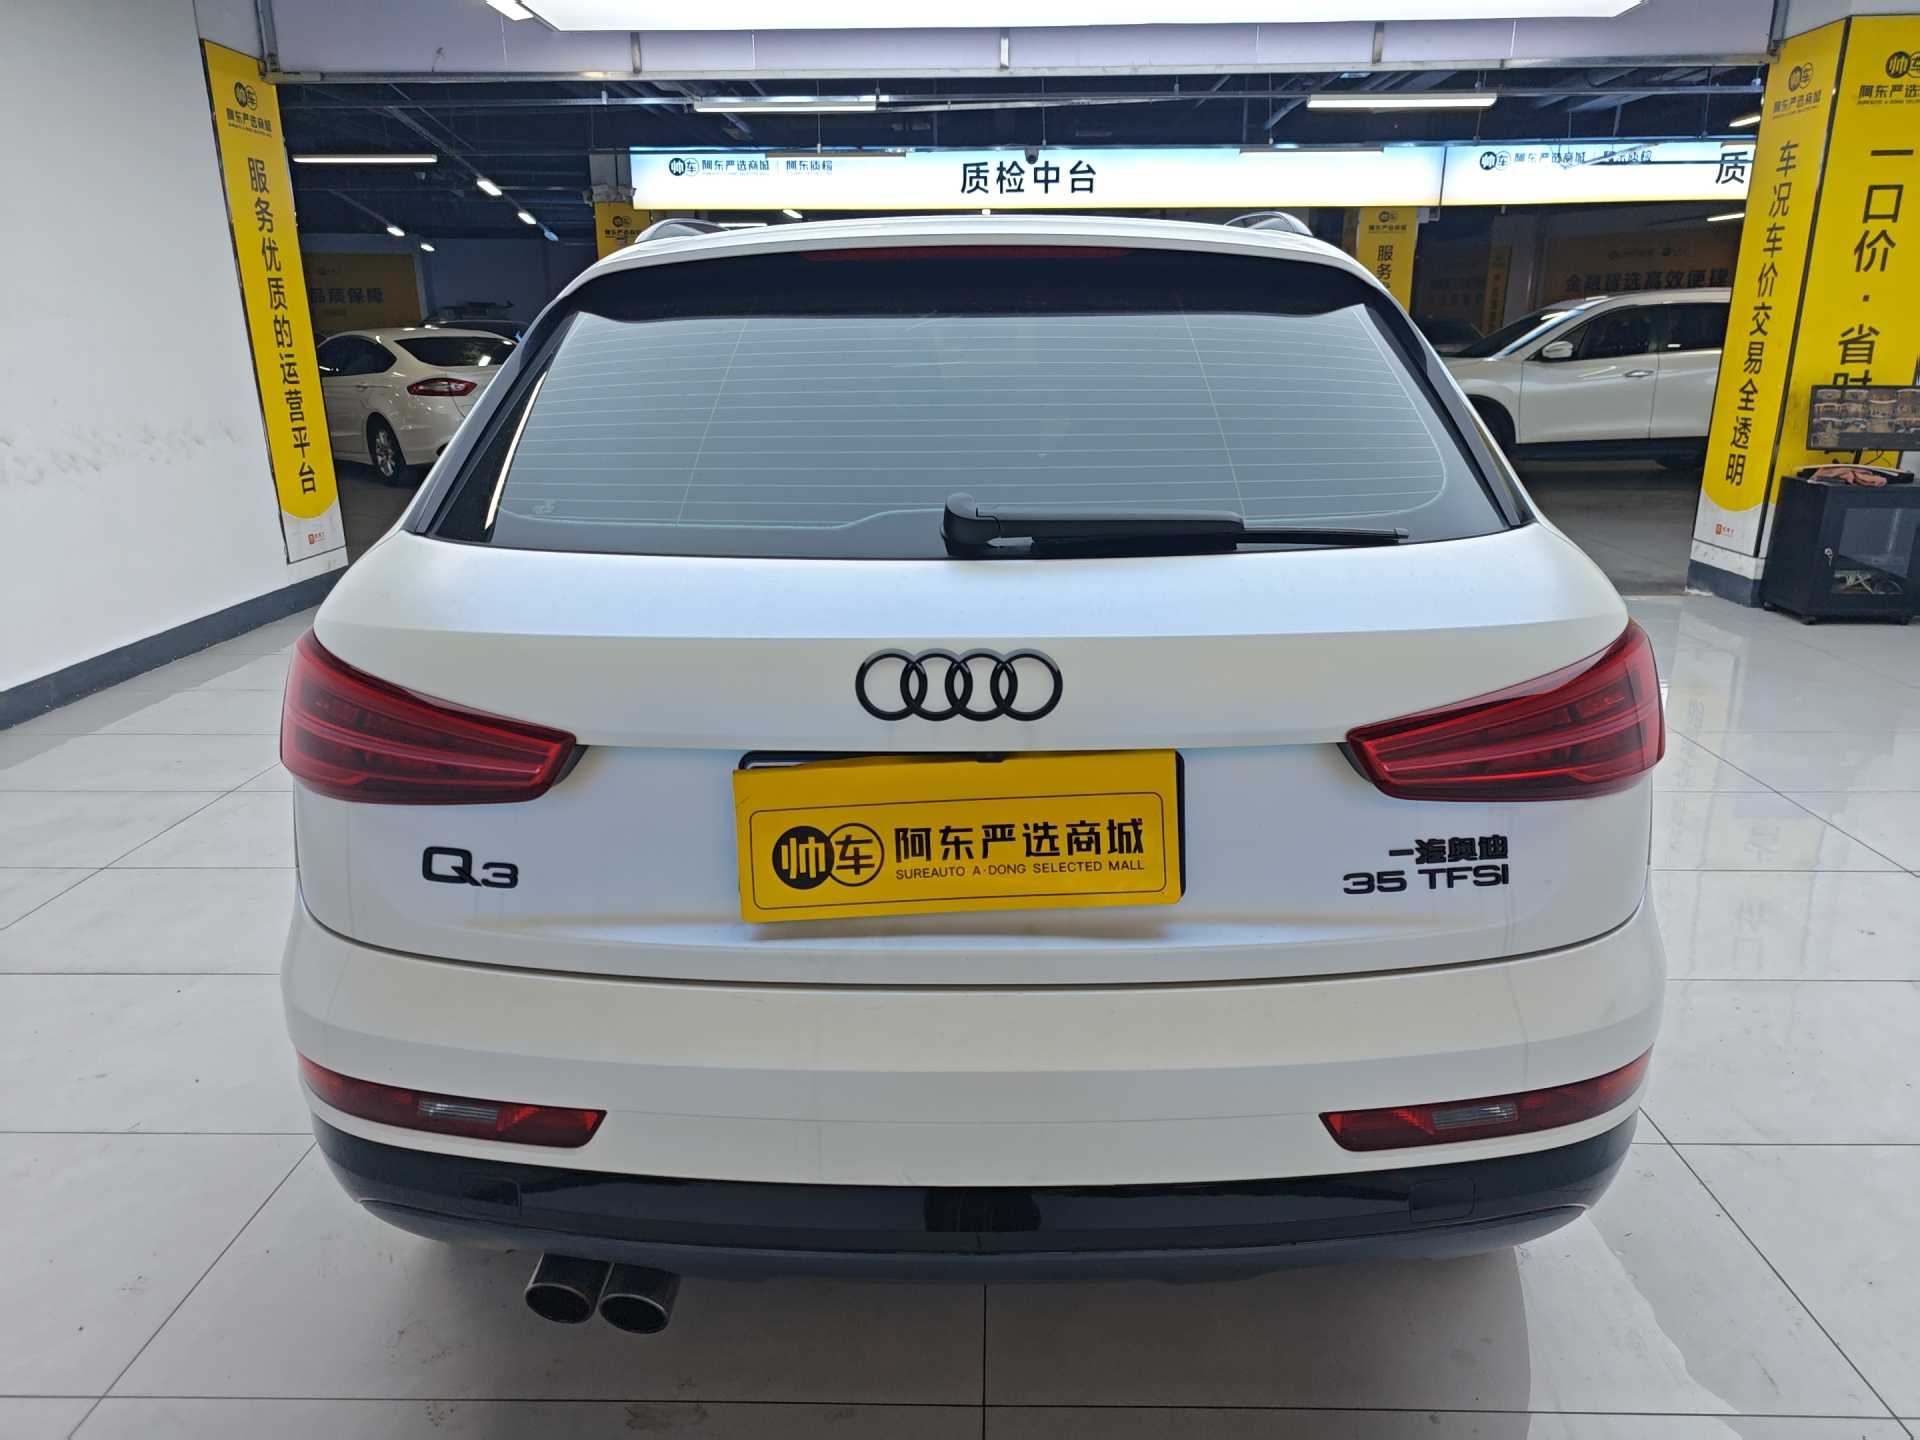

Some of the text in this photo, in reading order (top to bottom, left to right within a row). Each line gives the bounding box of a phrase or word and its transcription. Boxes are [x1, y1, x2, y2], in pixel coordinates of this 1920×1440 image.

[960, 160, 1097, 194] 质检中台
[248, 157, 316, 493] 服务优质的运营平台
[1725, 140, 1800, 486] 车况车价交易全透明
[895, 818, 1144, 863] 阿东严选商城
[422, 846, 519, 889] Q3
[896, 866, 966, 880] SUREAUTO
[1033, 860, 1103, 873] SELECTED
[1108, 859, 1145, 872] MALL
[1343, 864, 1509, 895] 35 TFSI
